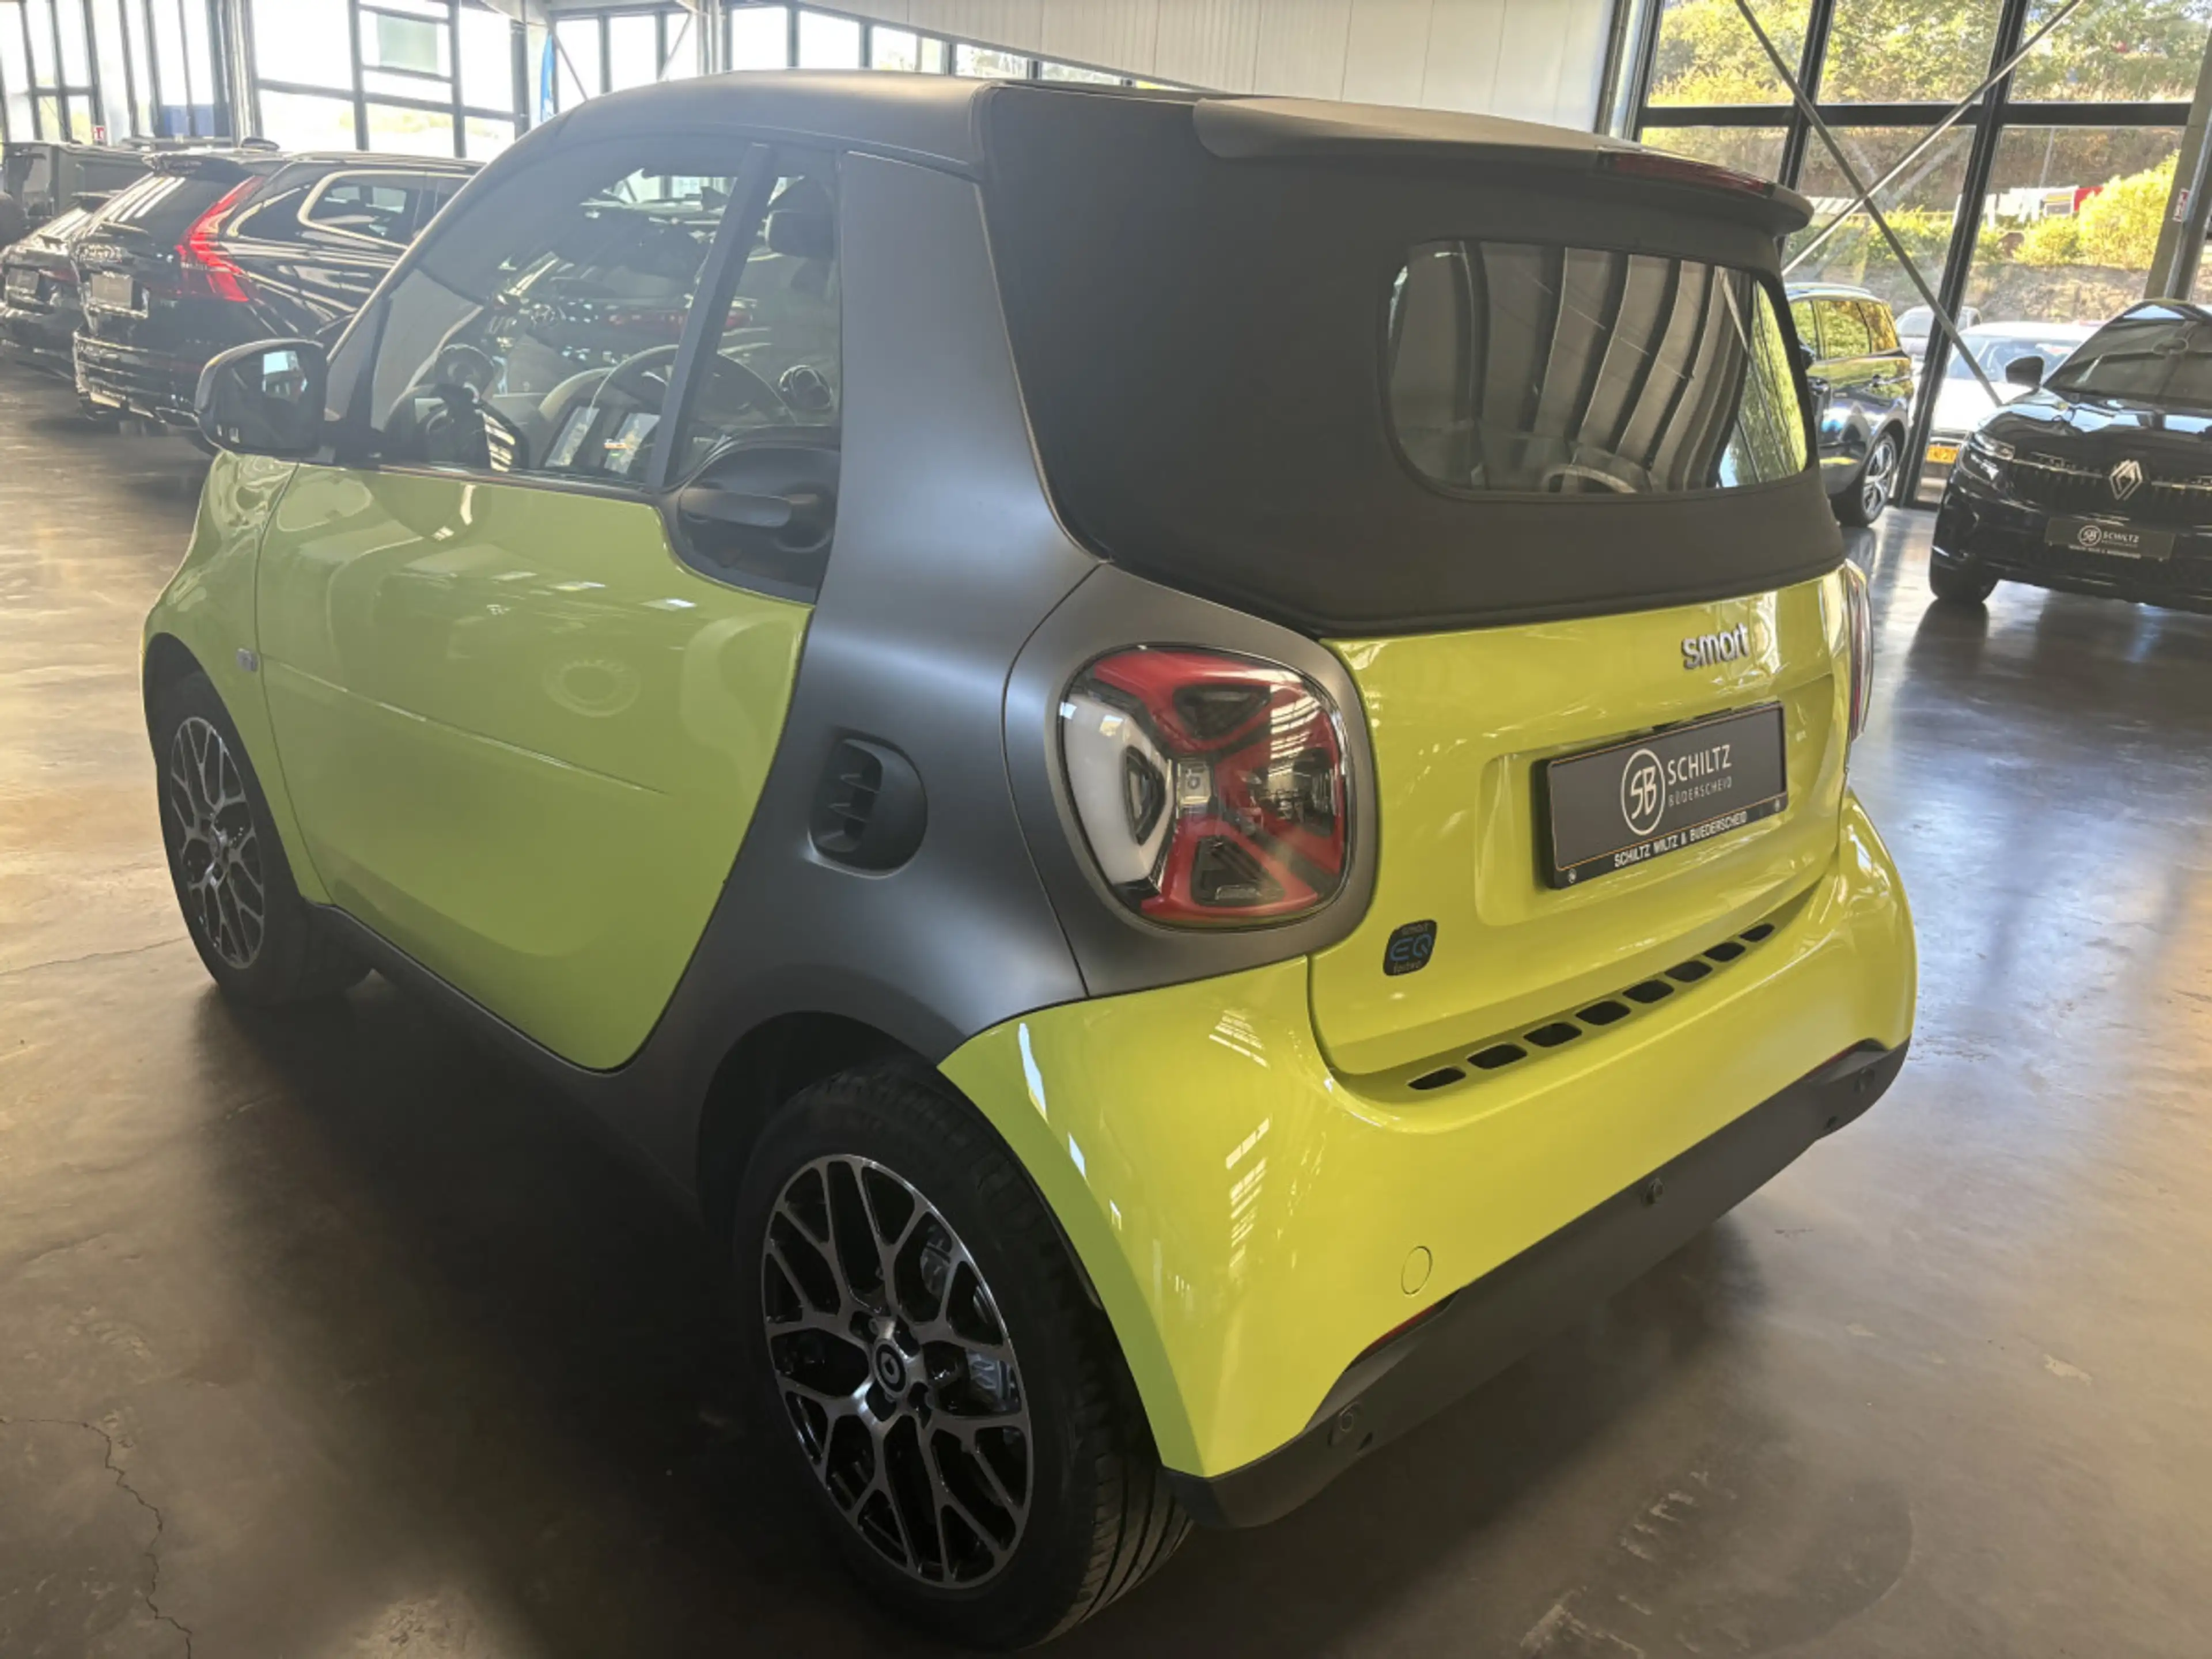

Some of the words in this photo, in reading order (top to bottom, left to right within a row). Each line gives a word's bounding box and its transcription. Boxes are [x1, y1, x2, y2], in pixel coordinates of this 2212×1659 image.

[1681, 622, 1749, 671] smart
[1668, 744, 1733, 786] SCHILTZ
[1614, 843, 1651, 868] SCHILTZ
[1690, 811, 1748, 842] BUEDERSCHEID
